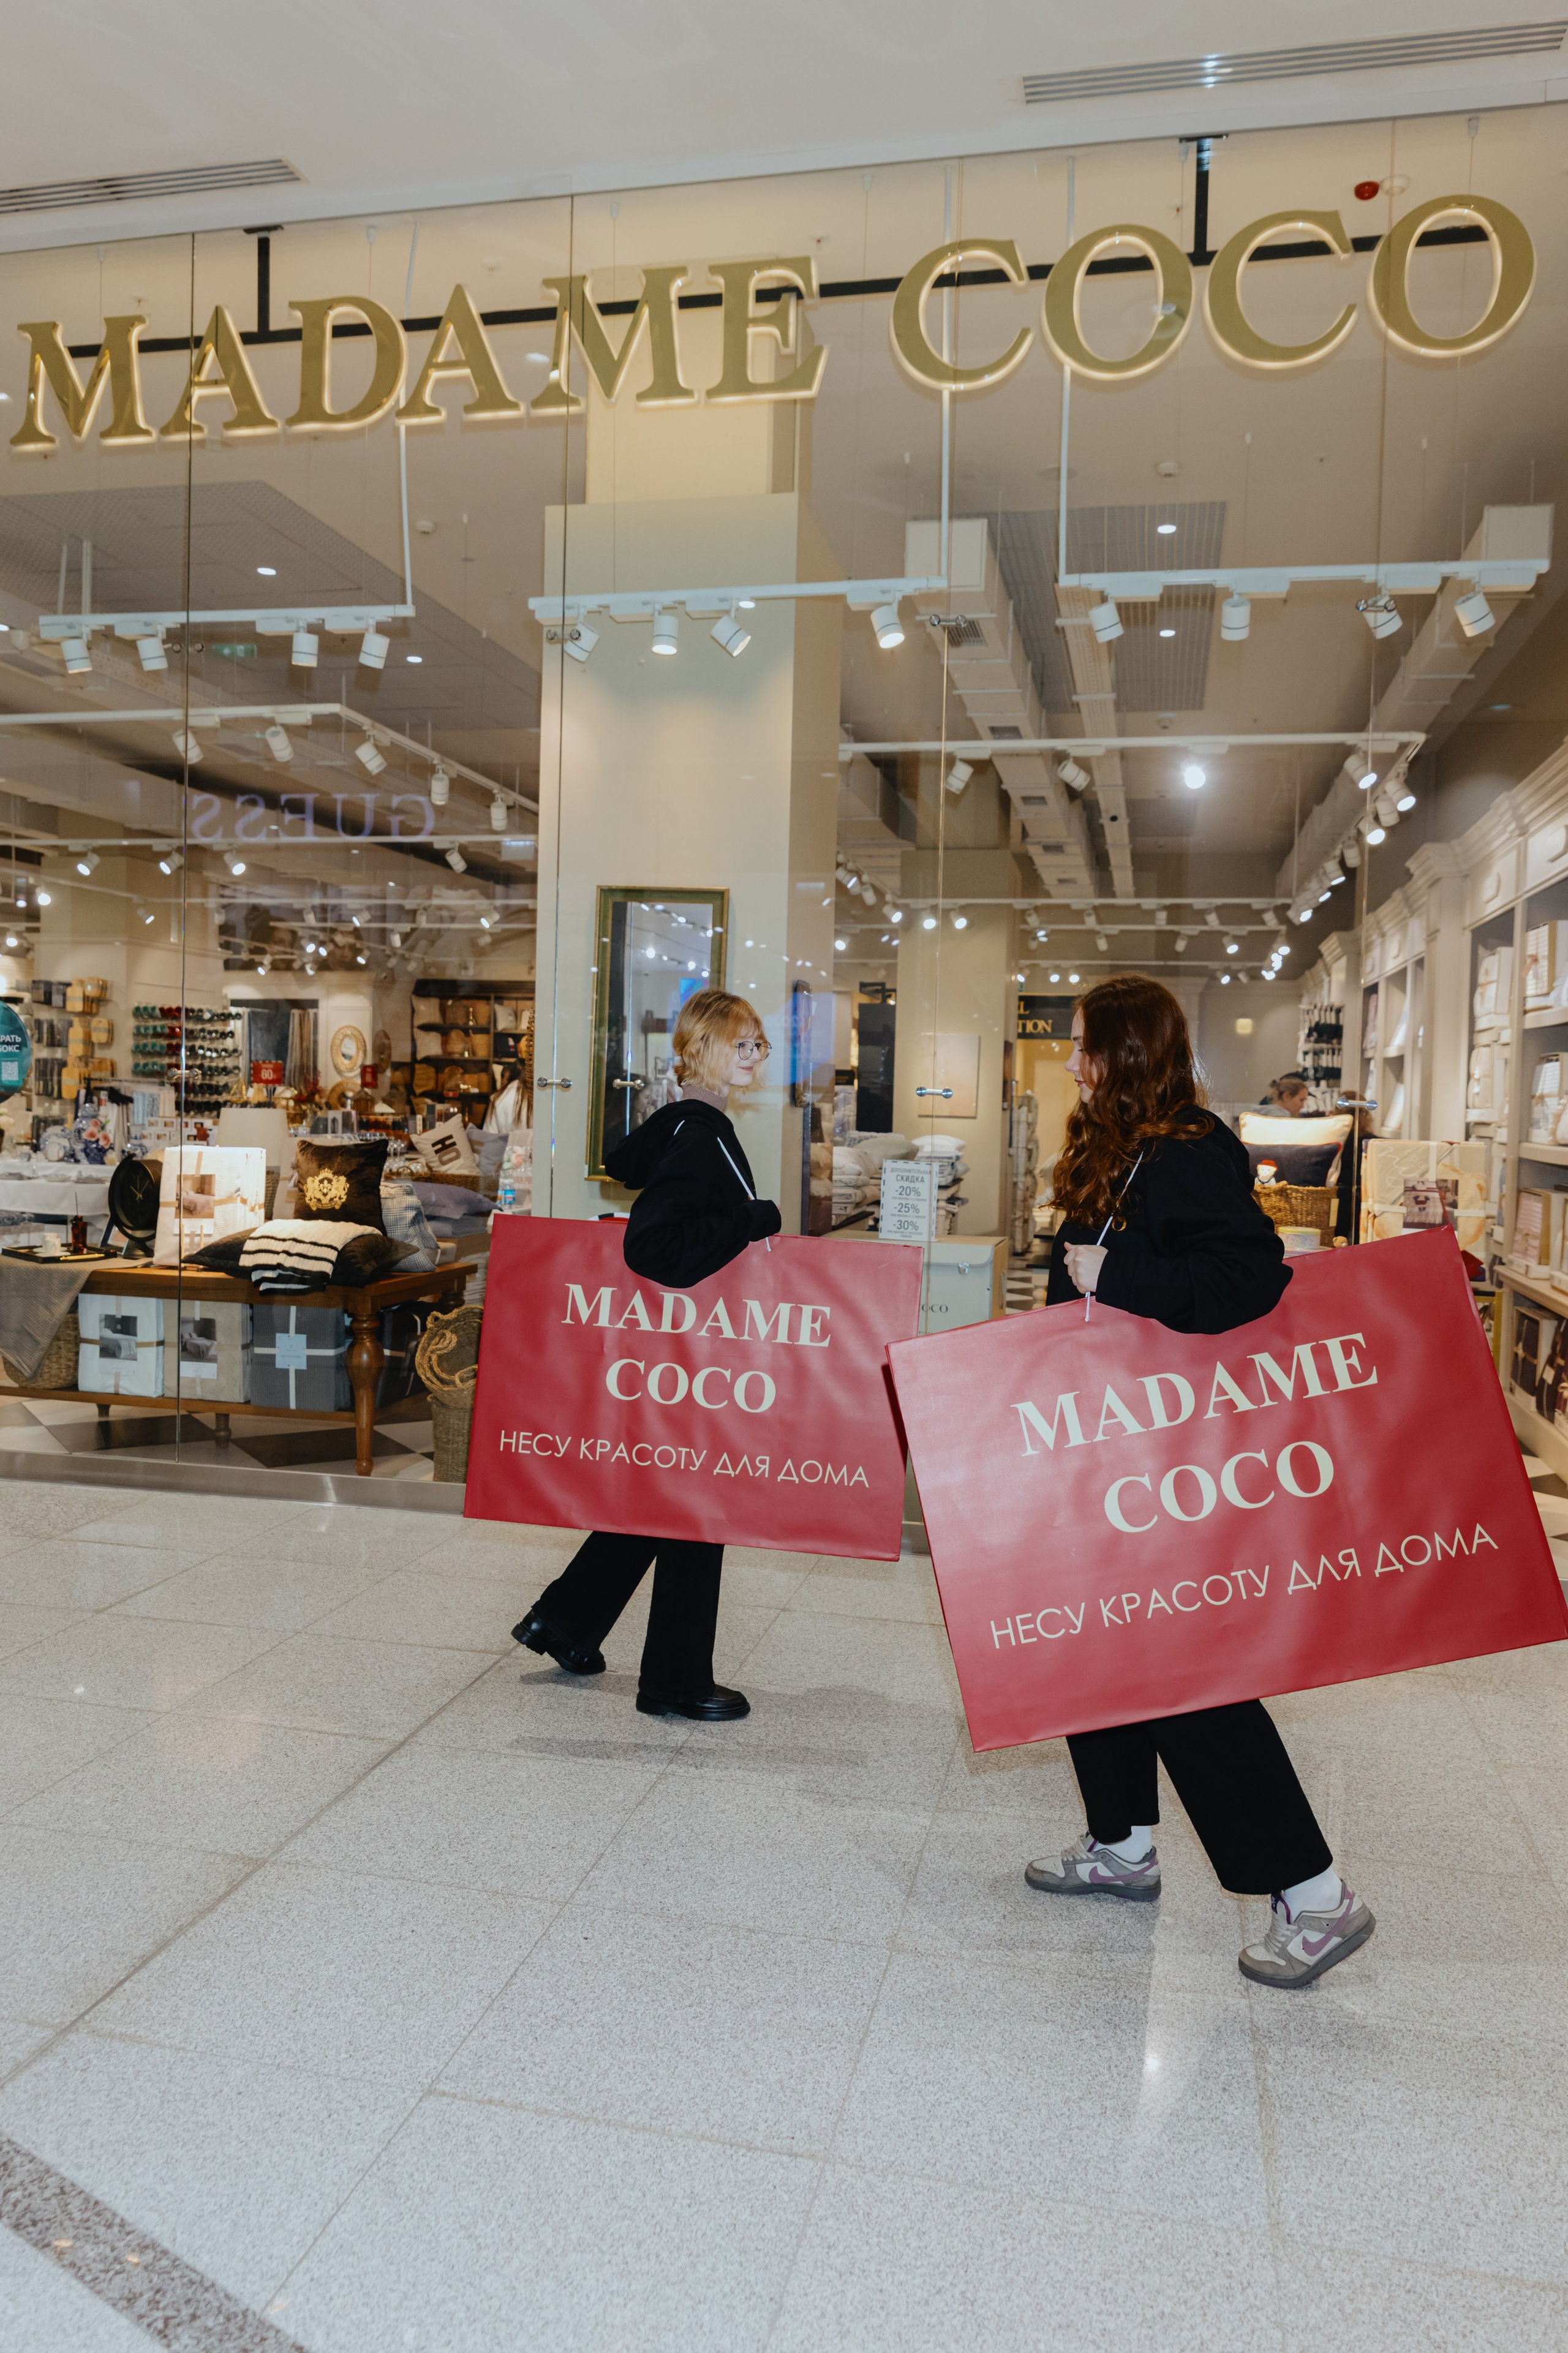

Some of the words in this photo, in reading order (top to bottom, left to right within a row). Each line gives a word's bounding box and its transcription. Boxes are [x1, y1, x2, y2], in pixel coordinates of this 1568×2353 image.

[10, 256, 827, 451] MADAME
[889, 194, 1537, 391] COCO
[895, 1186, 921, 1196] -20%
[896, 1174, 924, 1184] СКИДКА
[893, 1220, 919, 1231] -30%
[894, 1203, 919, 1214] -25%
[561, 1283, 831, 1347] MADAME
[606, 1359, 776, 1413] COCO
[1011, 1332, 1378, 1456] MADAME
[500, 1430, 571, 1457] НЕСУ
[579, 1438, 707, 1471] КРАСОТУ
[713, 1452, 769, 1478] ДЛЯ
[777, 1458, 869, 1488] ДОМА
[1104, 1441, 1334, 1533] COCO
[990, 1603, 1085, 1649] НЕСУ
[1099, 1565, 1270, 1627] КРАСОТУ
[1287, 1548, 1362, 1595] ДЛЯ
[1374, 1523, 1499, 1577] ДОМА
